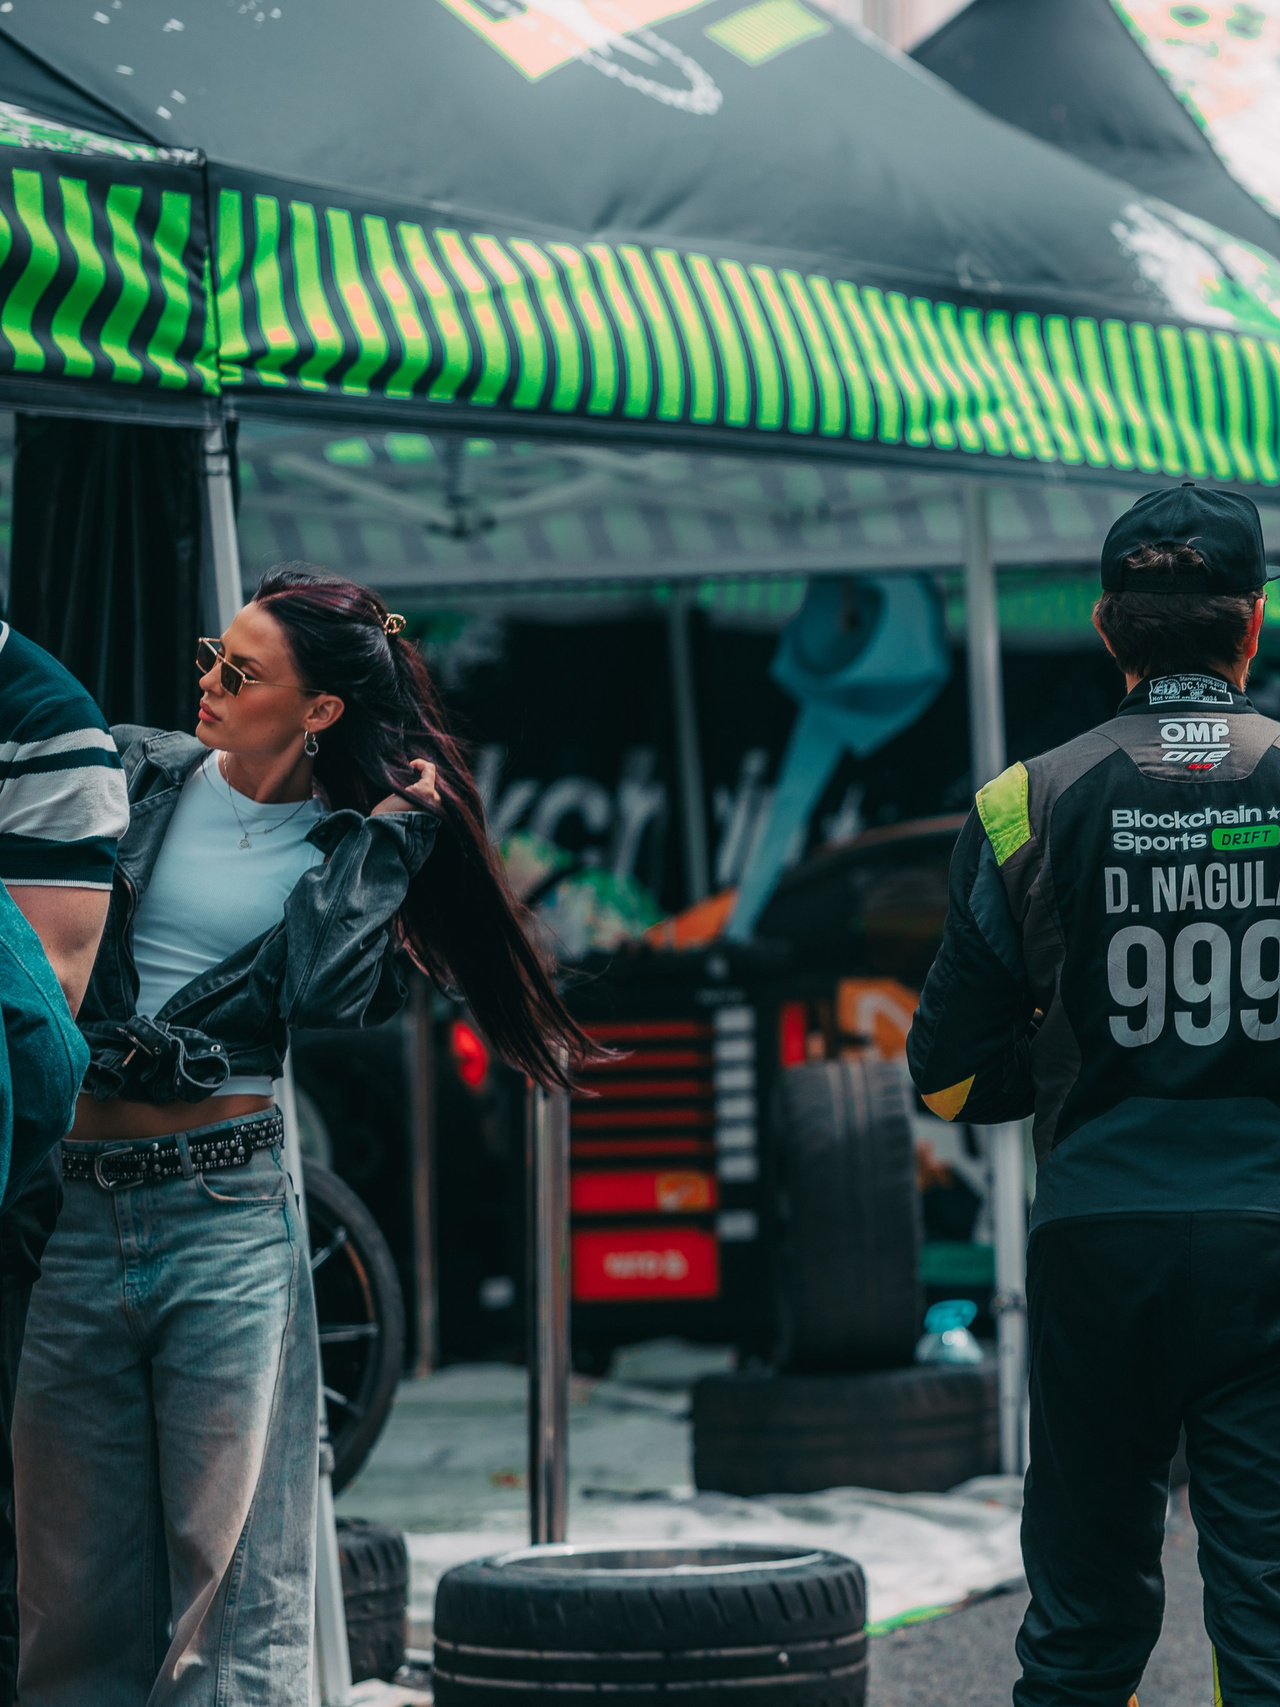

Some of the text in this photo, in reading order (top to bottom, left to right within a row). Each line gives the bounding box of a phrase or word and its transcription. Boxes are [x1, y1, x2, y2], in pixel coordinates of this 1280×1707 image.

[1160, 722, 1230, 743] OMP
[1111, 804, 1263, 830] Blockchain
[1112, 829, 1272, 854] Sports DRIFT
[1103, 866, 1140, 914] D.
